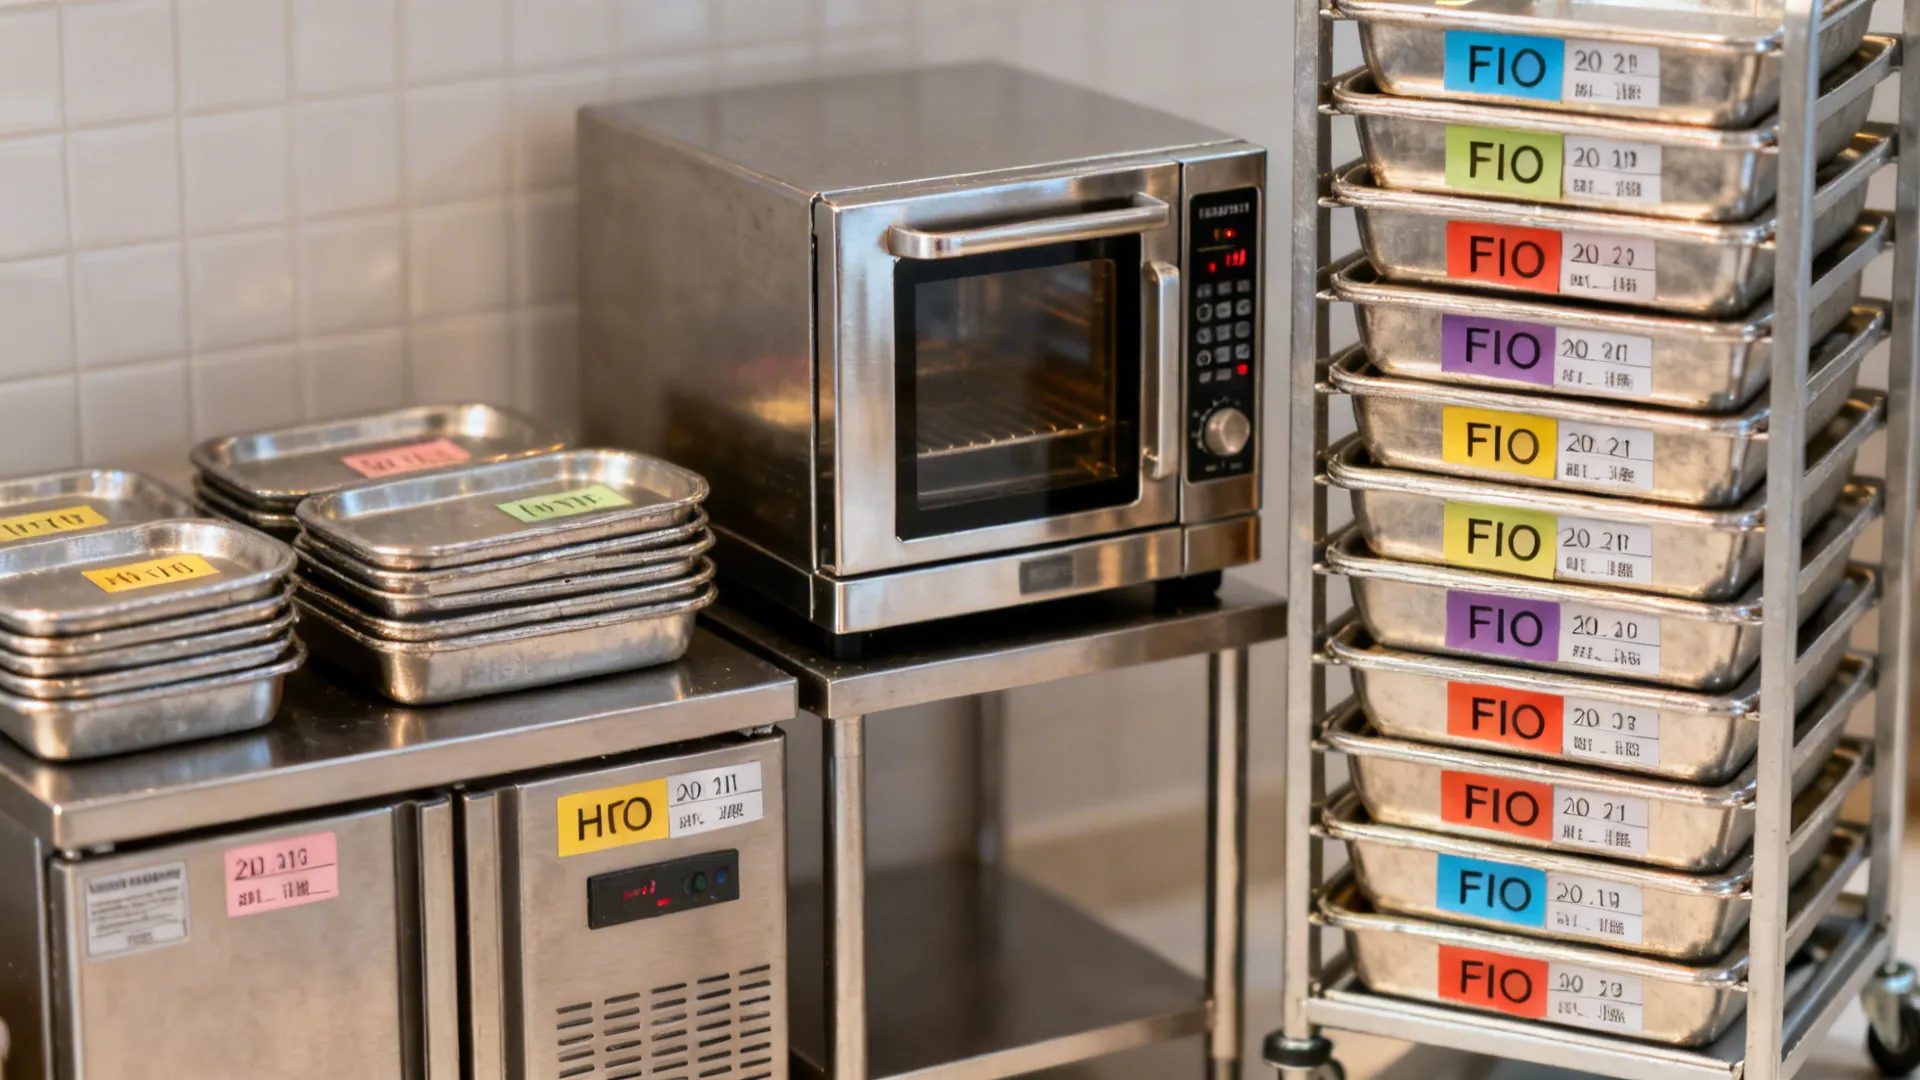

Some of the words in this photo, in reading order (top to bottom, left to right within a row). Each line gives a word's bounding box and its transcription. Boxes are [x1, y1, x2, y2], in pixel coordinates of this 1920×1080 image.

[1469, 45, 1546, 87] FIO
[1470, 141, 1543, 183] FIO
[1470, 235, 1544, 278] FIO
[1465, 327, 1541, 370] FIO
[1467, 422, 1540, 465] FIO
[1468, 518, 1541, 561] FIO
[1470, 605, 1543, 647] FIO
[1472, 697, 1545, 740] FIO
[1465, 784, 1539, 827] FIO
[1460, 869, 1532, 912] FIO
[1461, 960, 1533, 1003] FIO
